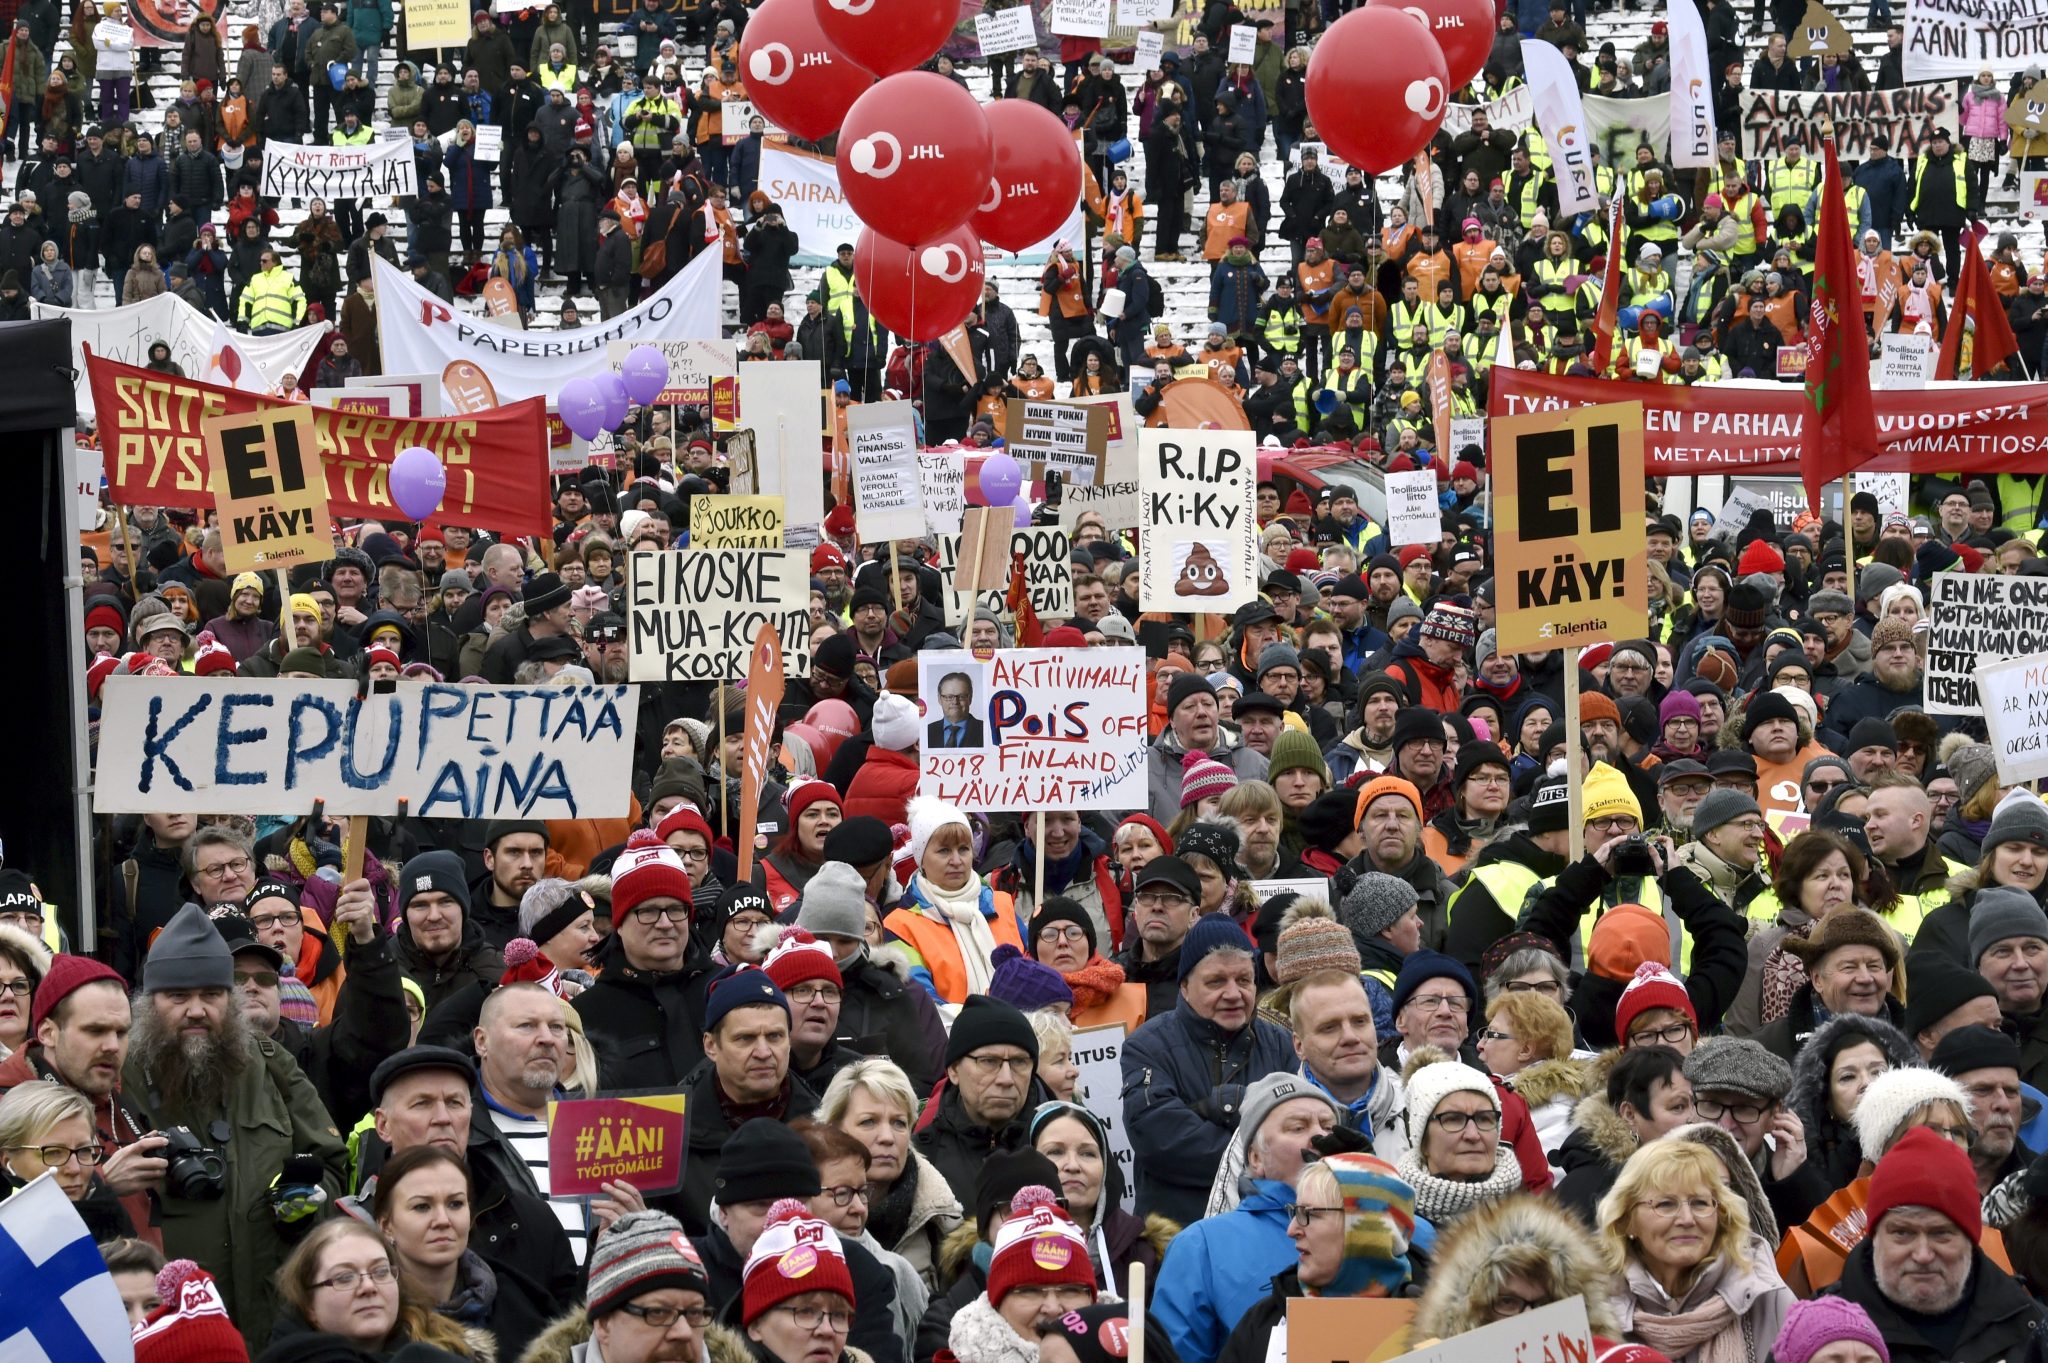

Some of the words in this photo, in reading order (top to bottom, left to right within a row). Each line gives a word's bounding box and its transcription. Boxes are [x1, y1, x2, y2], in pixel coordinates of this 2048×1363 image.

[437, 2, 459, 10] MALLI
[1136, 7, 1156, 17] EK
[1435, 15, 1464, 29] JHL
[1909, 16, 1968, 59] ÄÄNI
[799, 50, 832, 67] JHL
[1750, 90, 1805, 121] ÄLÄ
[1811, 91, 1893, 119] ANNA
[1893, 83, 1952, 118] RIIS-
[295, 152, 324, 166] NYT
[908, 145, 945, 160] JHL
[264, 152, 412, 198] KYYKYTTÄJÄT
[1006, 182, 1040, 198] JHL
[663, 343, 688, 358] KOP
[1887, 344, 1925, 355] Teollisuus
[1899, 353, 1918, 362] liitto
[677, 373, 707, 384] 1956
[1175, 368, 1207, 376] ANKAISU
[1886, 370, 1921, 379] KYYKYTYS
[115, 377, 227, 437] SOTE
[1027, 407, 1053, 419] VALHE
[1057, 409, 1084, 422] PUKKI
[1877, 404, 2029, 433] VUODESTA
[856, 432, 884, 444] ALAS
[1025, 428, 1052, 441] HYVIN
[1055, 432, 1084, 444] VOINTI
[857, 441, 907, 454] FINANSSI-
[220, 419, 306, 501] EI
[858, 454, 893, 465] VALTA!
[1011, 448, 1046, 461] VALTION
[1050, 452, 1096, 467] VARTIJANA
[1158, 442, 1242, 486] R.I.P.
[860, 472, 899, 483] PÄÄOMAT
[861, 481, 898, 492] VEROLLE
[1516, 423, 1622, 543] EI
[862, 490, 903, 501] MILJARDIT
[1390, 484, 1433, 495] Teollisuus
[1406, 492, 1427, 502] liitto
[863, 499, 906, 510] KANSALLE
[1152, 492, 1240, 530] Ki-Ky
[1405, 505, 1421, 513] ÄÄNI
[233, 506, 314, 544] KÄY!
[706, 506, 782, 535] JOUKKO-
[1391, 511, 1437, 522] TYÖTTÖMÄLLE
[1317, 532, 1332, 542] NYC
[264, 548, 304, 561] Talentia
[633, 553, 665, 606] EI
[676, 552, 783, 605] KOSKE
[1517, 553, 1626, 610] KÄY!
[1940, 578, 1969, 603] EN
[1974, 577, 2004, 605] NÄE
[1932, 602, 2020, 631] TYÖTTÖMÄN
[633, 610, 810, 656] MUA-KOHTA
[1553, 617, 1607, 637] Talentia
[1928, 627, 1975, 650] MUUN
[1977, 629, 2016, 655] KUIN
[665, 650, 806, 681] KOSKE!
[1928, 650, 1978, 675] TÖITÄ
[1102, 714, 1148, 738] OFF
[137, 692, 404, 795] KEPU
[415, 684, 629, 771] PETTÄÄ
[925, 755, 985, 778] 2018
[417, 745, 578, 819] AINA
[1594, 797, 1631, 810] Talentia
[245, 883, 287, 907] LAPPI
[727, 896, 765, 916] LAPPI
[1072, 1045, 1117, 1067] ITUS
[120, 1107, 142, 1136] Canon
[575, 1117, 665, 1163] #ÄÄNI
[576, 1155, 663, 1181] TYÖTTÖMÄLLE
